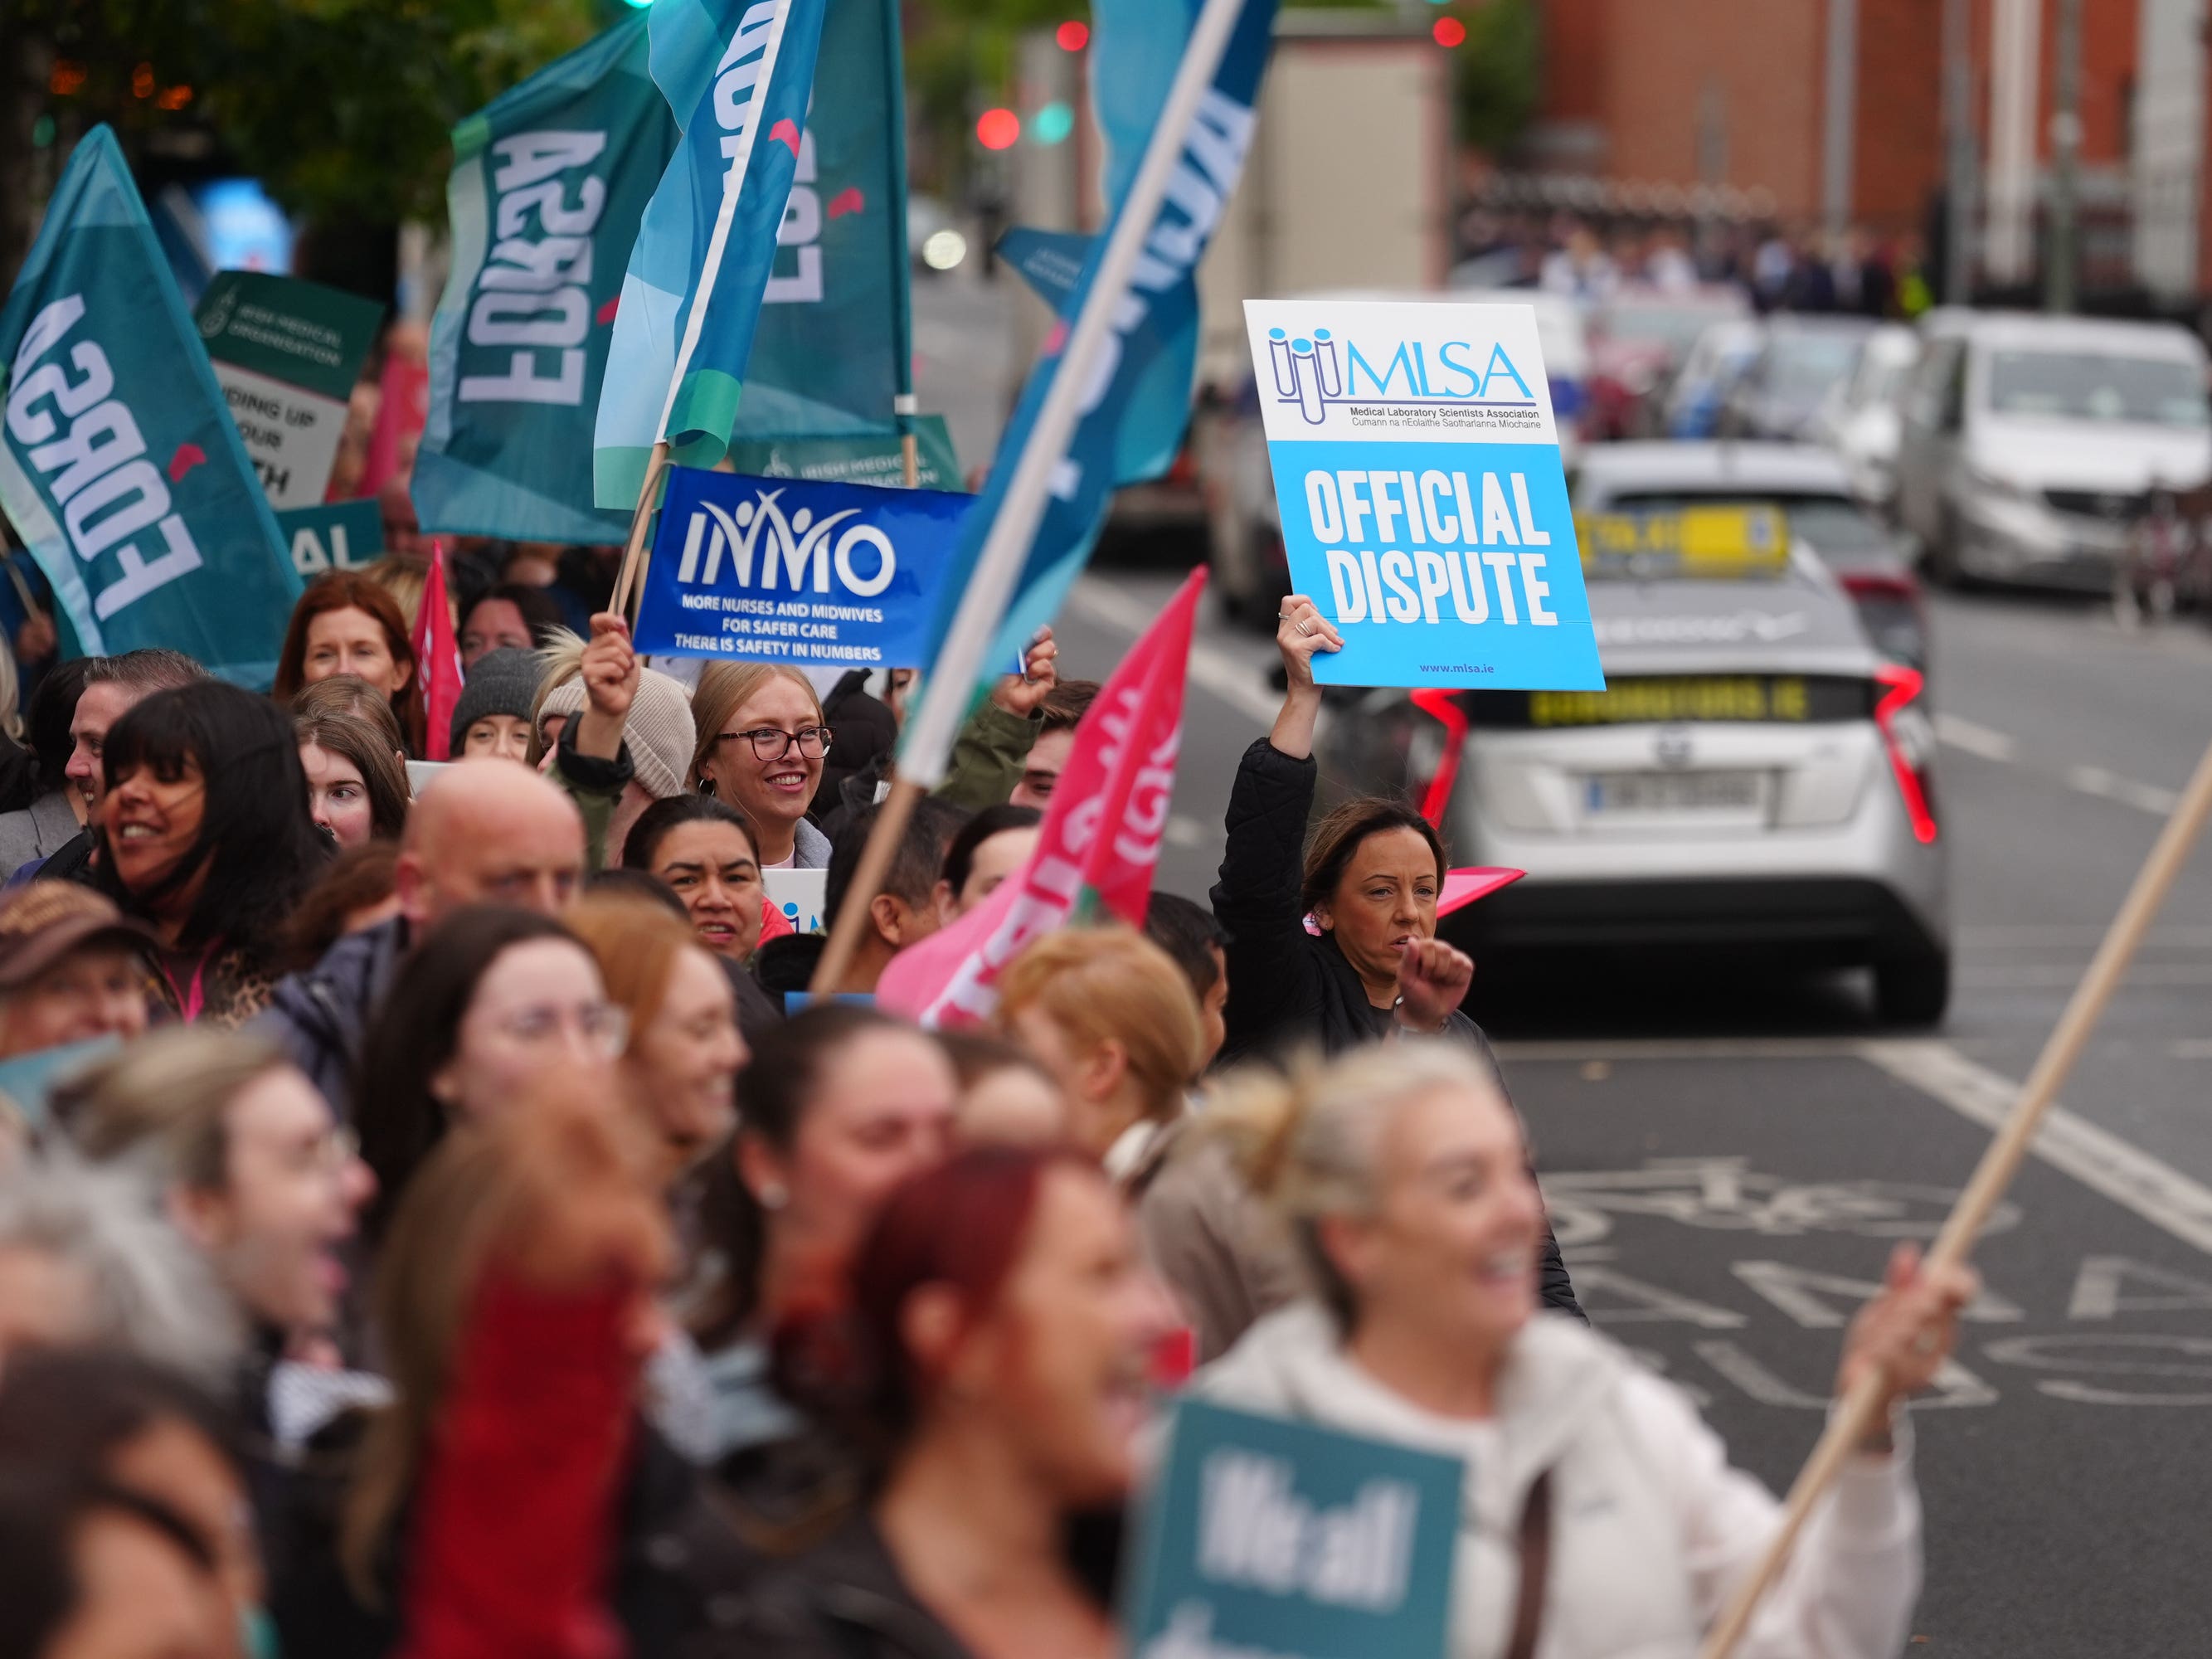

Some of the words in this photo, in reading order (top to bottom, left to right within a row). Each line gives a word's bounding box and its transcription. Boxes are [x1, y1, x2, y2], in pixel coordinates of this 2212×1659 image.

[1347, 339, 1534, 399] MLSA
[1350, 407, 1385, 416] Medical
[1387, 407, 1437, 419] Laboratory
[1439, 408, 1484, 417] Scientists
[1486, 409, 1539, 419] Association
[1352, 417, 1388, 426] Cumann
[1402, 417, 1441, 427] nEolaithe
[800, 461, 845, 479] IRISH
[1305, 469, 1550, 546] OFFICIAL
[678, 488, 896, 597] INMO
[1325, 550, 1558, 625] DISPUTE
[682, 594, 719, 611] MORE
[722, 597, 774, 615] NURSES
[776, 602, 809, 618] AND
[812, 605, 882, 623] MIDWIVES
[722, 617, 751, 632] FOR
[753, 620, 798, 637] SAFER
[800, 624, 838, 640] CARE
[674, 633, 717, 651] THERE
[721, 637, 733, 652] IS
[737, 638, 790, 656] SAFETY
[793, 643, 808, 657] IN
[810, 644, 882, 661] NUMBERS
[1420, 664, 1495, 674] www.mlsa.ie
